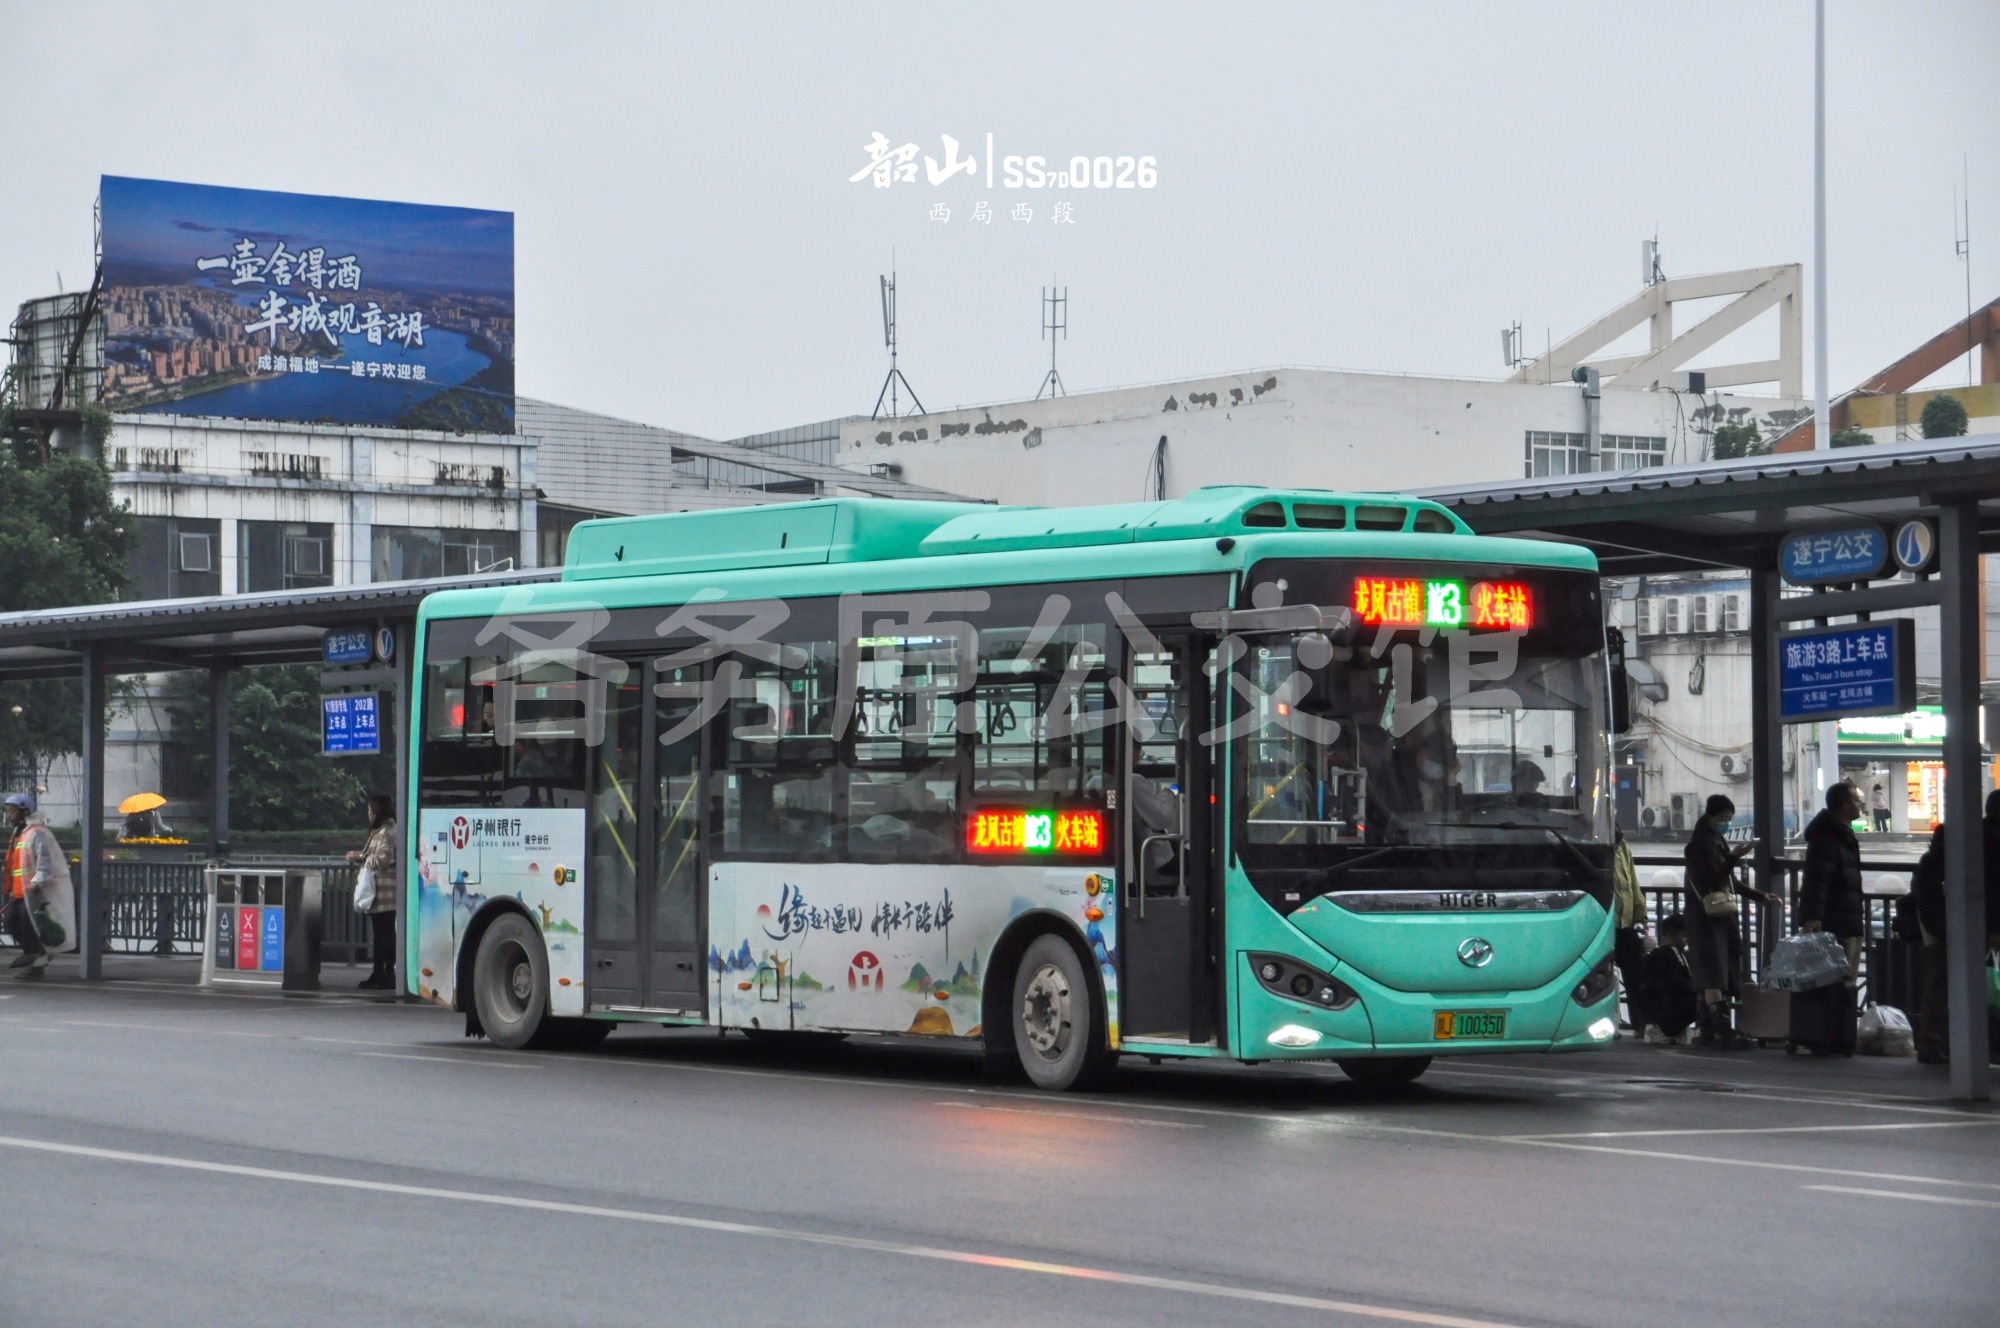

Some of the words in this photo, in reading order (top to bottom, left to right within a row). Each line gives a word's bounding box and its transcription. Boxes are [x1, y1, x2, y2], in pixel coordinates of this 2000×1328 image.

[197, 237, 362, 291] 一壶舍得酒
[245, 291, 429, 355] 半城观音湖
[1794, 532, 1873, 566] 遂宁公交
[1476, 584, 1527, 626] 火车站
[328, 633, 366, 653] 遂宁公交
[1786, 633, 1888, 669] 旅游3路上车点
[1834, 671, 1839, 679] 3
[1840, 669, 1854, 678] bus
[1856, 668, 1873, 678] stop
[329, 715, 347, 730] 上车点
[355, 714, 376, 729] 上车点
[472, 818, 521, 837] 泸州银行
[1056, 814, 1099, 848] 火车站
[473, 840, 498, 848] LUZHOU
[503, 840, 521, 848] BANK
[1439, 893, 1498, 908] HIGER
